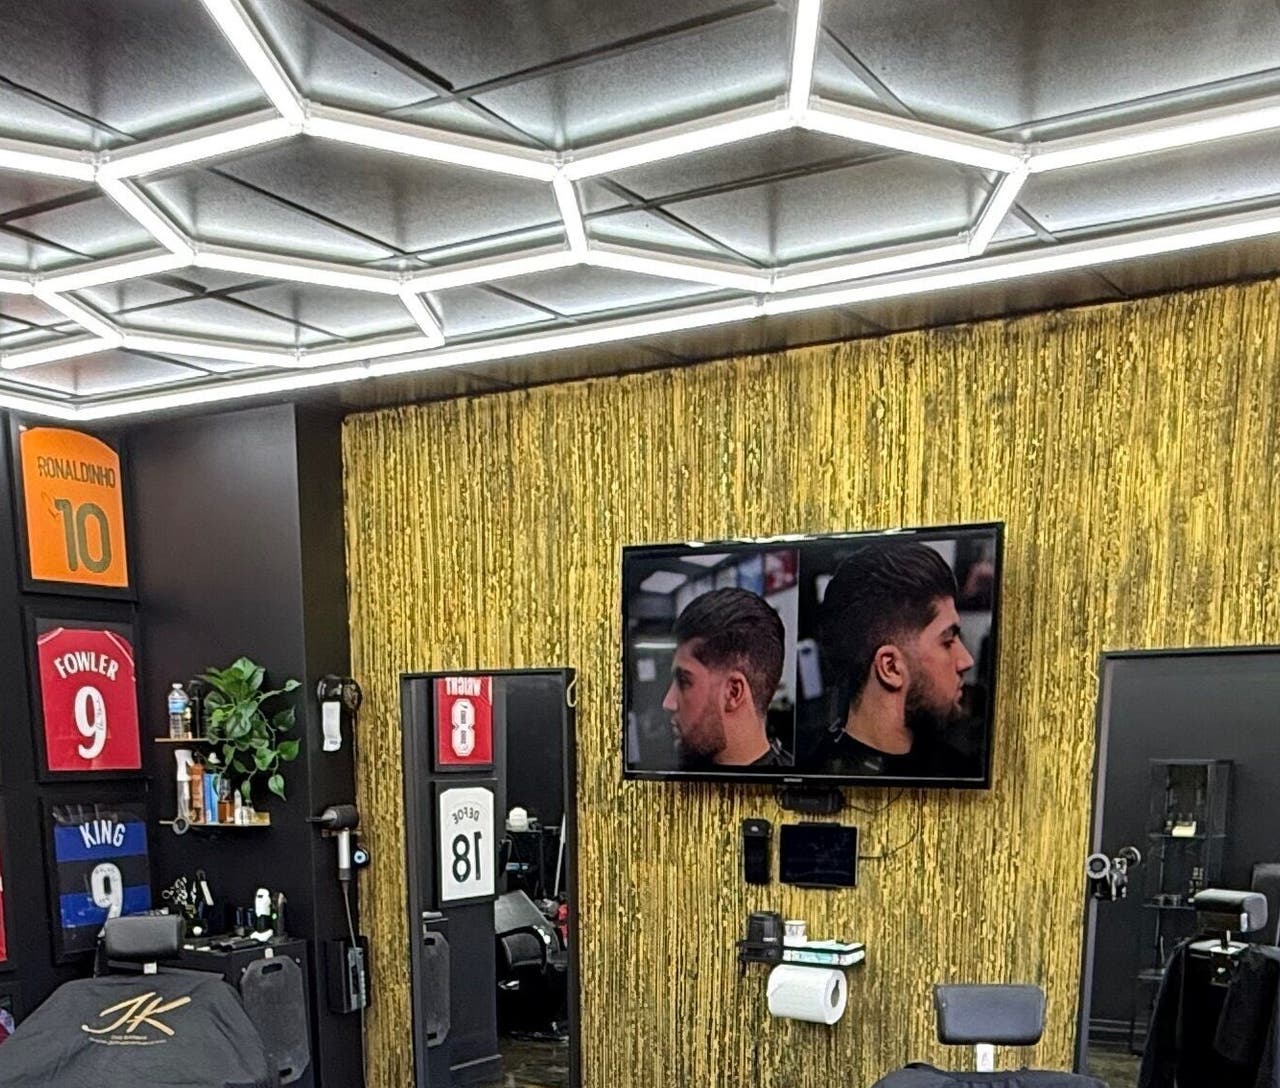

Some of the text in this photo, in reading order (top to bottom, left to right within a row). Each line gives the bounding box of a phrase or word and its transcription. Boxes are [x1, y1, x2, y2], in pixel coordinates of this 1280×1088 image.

[37, 455, 116, 489] RONALDINHO
[55, 498, 113, 574] 10
[54, 652, 119, 681] FOWLER
[74, 685, 108, 760] 9
[79, 819, 127, 849] KING
[91, 862, 124, 938] 9
[81, 991, 192, 1036] JK
